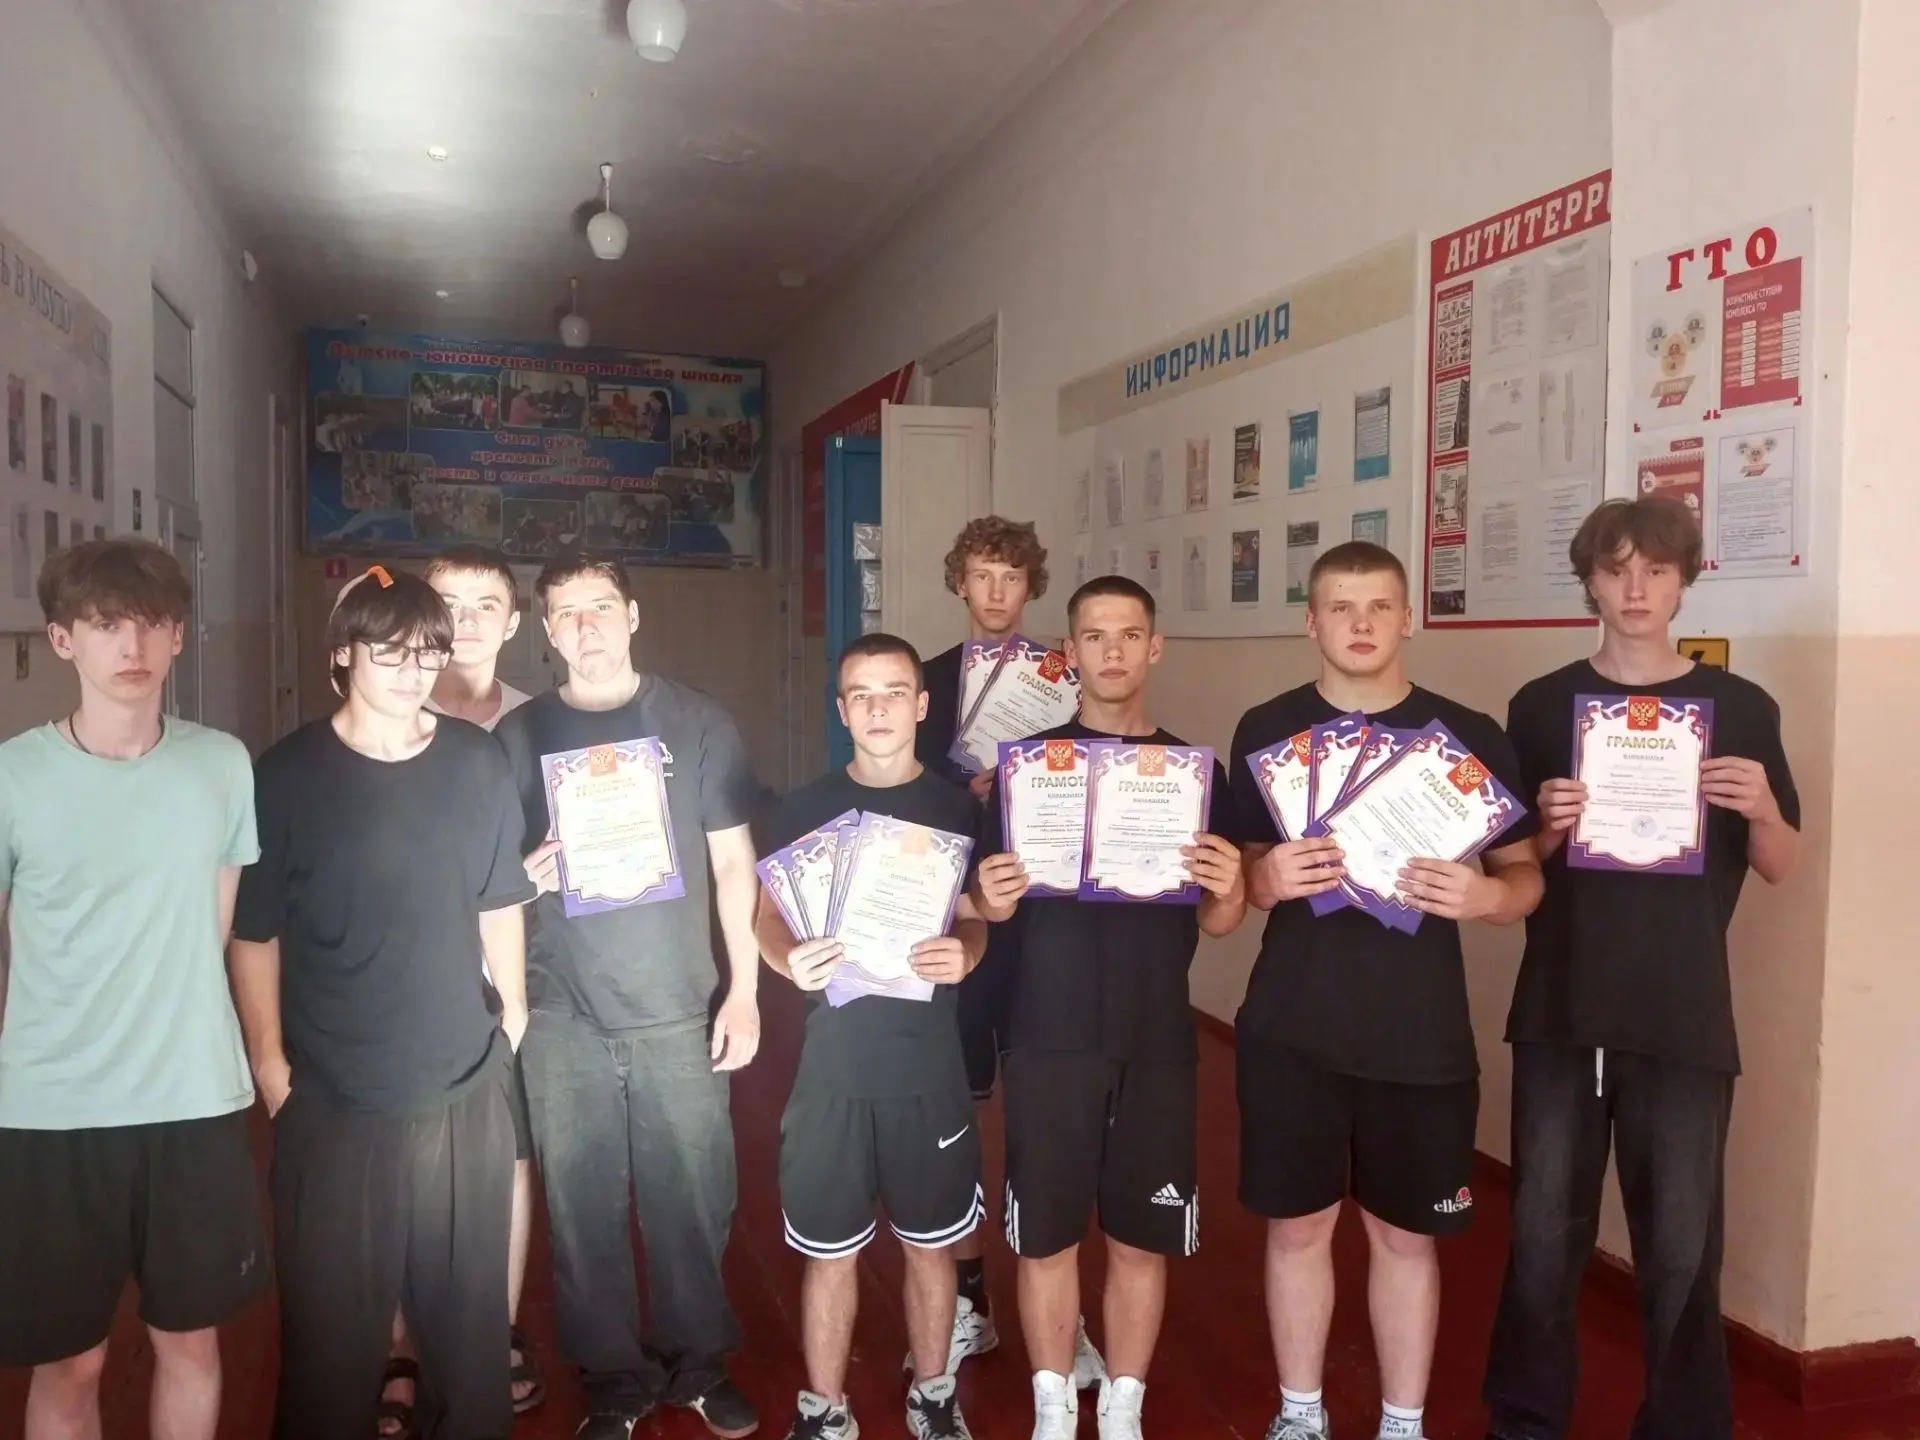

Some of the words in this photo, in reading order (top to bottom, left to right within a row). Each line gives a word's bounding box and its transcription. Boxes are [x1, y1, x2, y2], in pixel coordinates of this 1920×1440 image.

[1666, 227, 1777, 291] ГТО
[1125, 301, 1290, 398] ИНФОРМАЦИЯ
[1017, 671, 1063, 704] ГРАМОТА
[1606, 735, 1677, 750] ГРАМОТА
[1118, 780, 1182, 794] ГРАМОТА
[1419, 768, 1469, 822] ГРАМОТА
[1151, 1196, 1184, 1207] adidas
